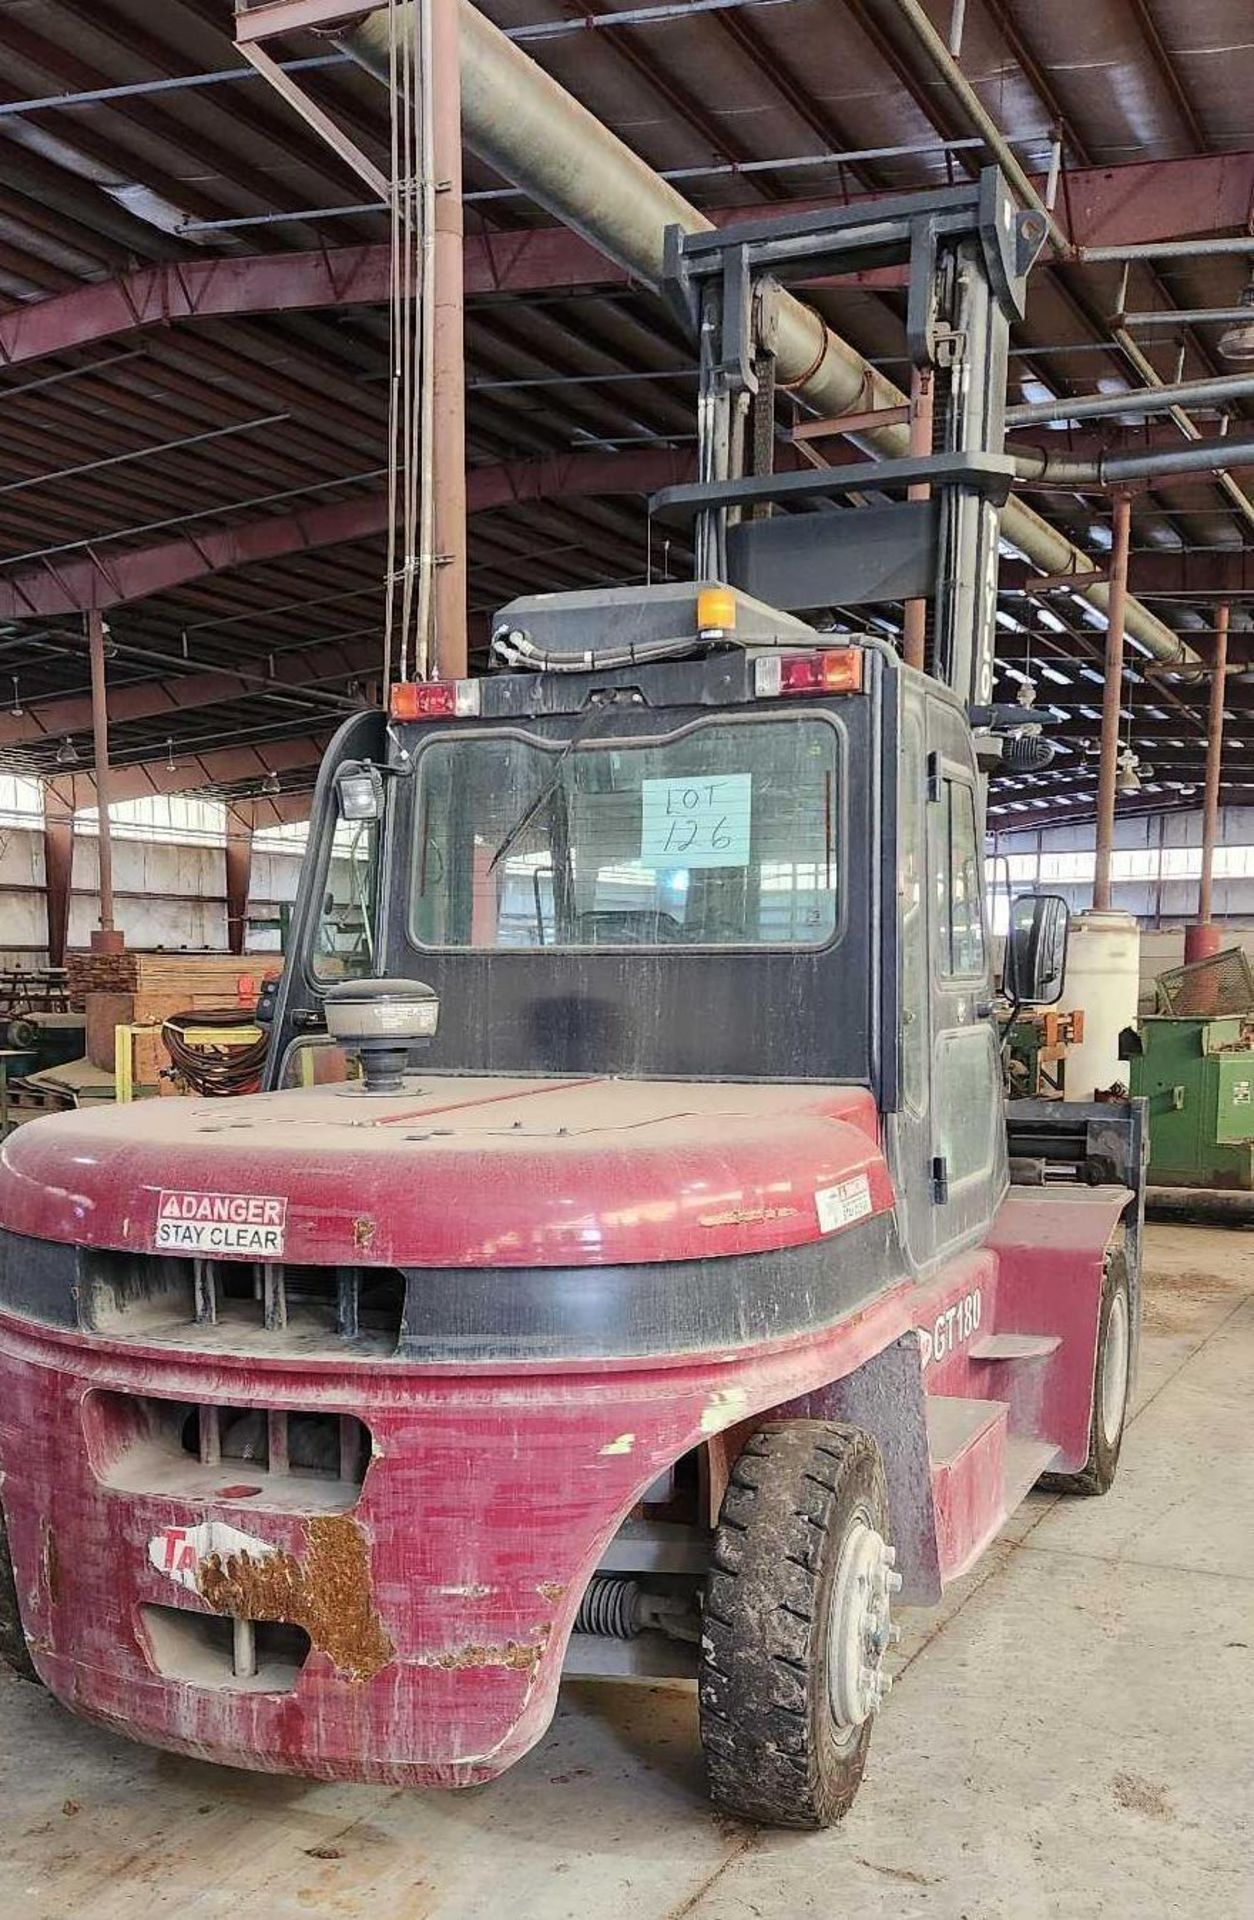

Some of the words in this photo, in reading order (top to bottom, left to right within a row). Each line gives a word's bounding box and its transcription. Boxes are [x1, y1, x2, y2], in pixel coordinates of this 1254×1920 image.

[981, 509, 998, 706] TAYLO
[666, 782, 729, 815] LOT
[663, 816, 732, 852] 126
[182, 1196, 281, 1225] DANGER
[160, 1224, 205, 1244] STAY
[210, 1227, 278, 1249] CLEAR
